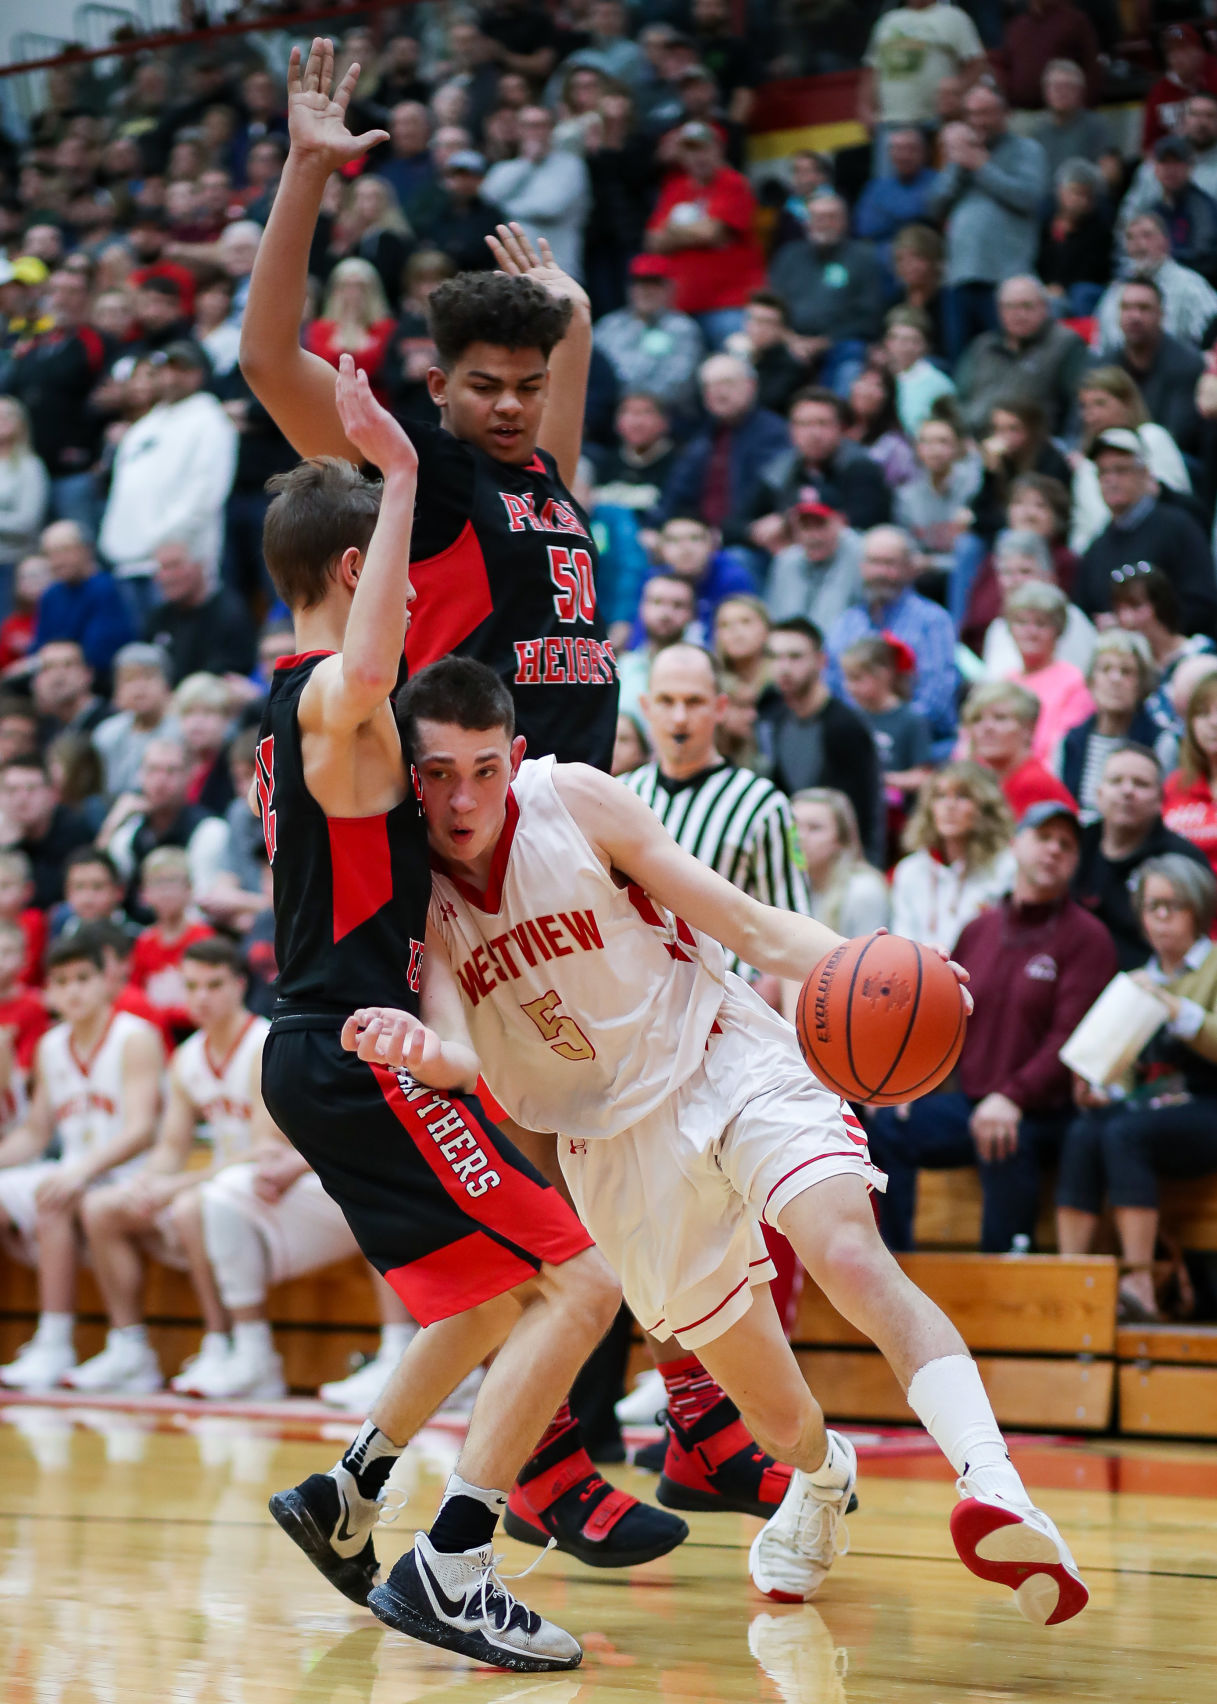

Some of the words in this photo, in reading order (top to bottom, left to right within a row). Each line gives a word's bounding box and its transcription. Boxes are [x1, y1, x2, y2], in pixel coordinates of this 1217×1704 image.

[547, 545, 596, 625] 50
[520, 989, 596, 1061] 5
[815, 945, 847, 1043] EVOLUTION
[388, 1065, 501, 1198] ANTHERS
